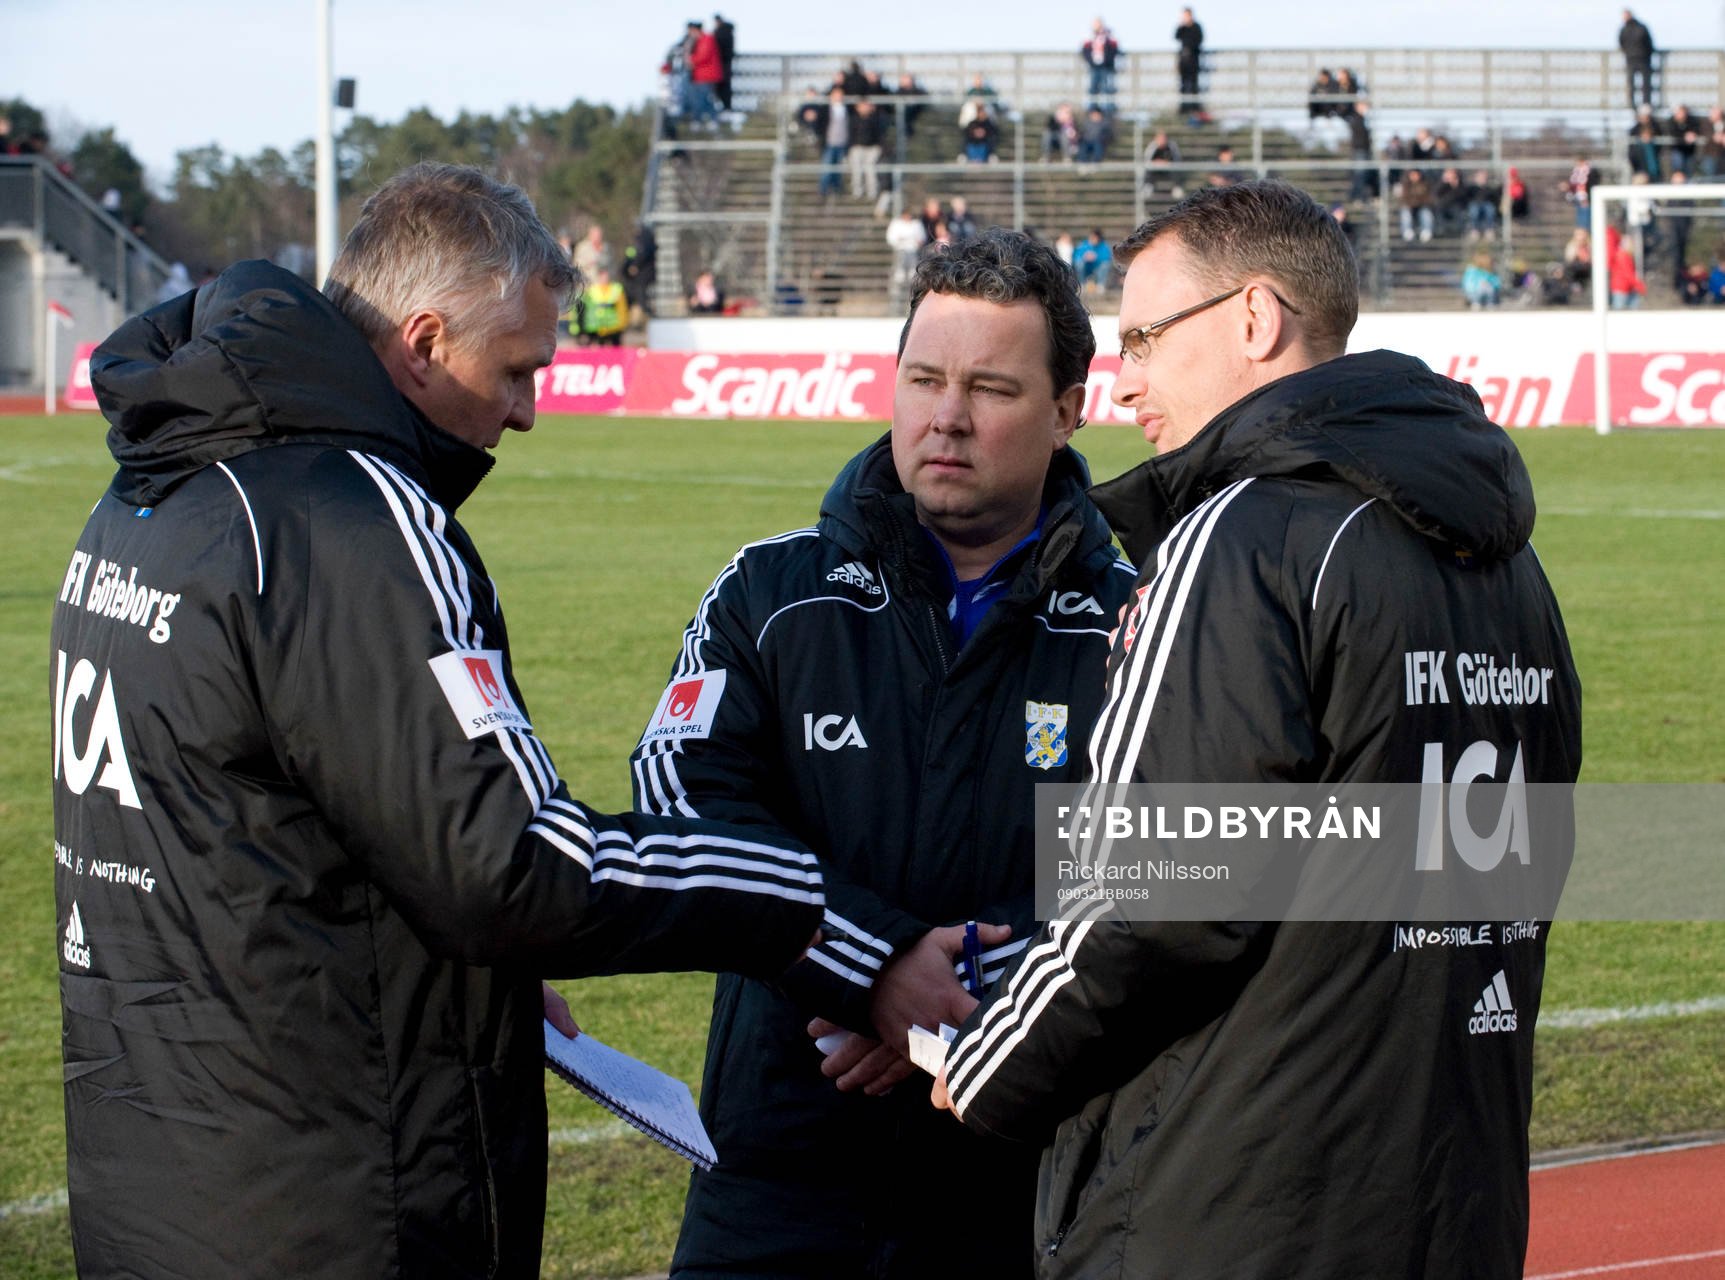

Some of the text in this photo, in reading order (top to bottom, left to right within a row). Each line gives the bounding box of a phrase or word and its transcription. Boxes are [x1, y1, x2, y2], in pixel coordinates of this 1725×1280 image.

[552, 364, 625, 397] TELIA
[672, 353, 876, 416] Scandic
[826, 571, 882, 595] adidas
[86, 558, 181, 644] Göteborg
[1048, 590, 1104, 615] ICA
[1404, 650, 1554, 706] IFK Götebor
[54, 650, 143, 809] ICA
[678, 724, 703, 735] SPEL
[803, 712, 869, 751] ICA
[1415, 739, 1531, 872] ICA
[89, 858, 155, 893] NOTHING
[1393, 922, 1493, 953] IMPOSSIBLE
[1468, 1008, 1518, 1035] adidas
